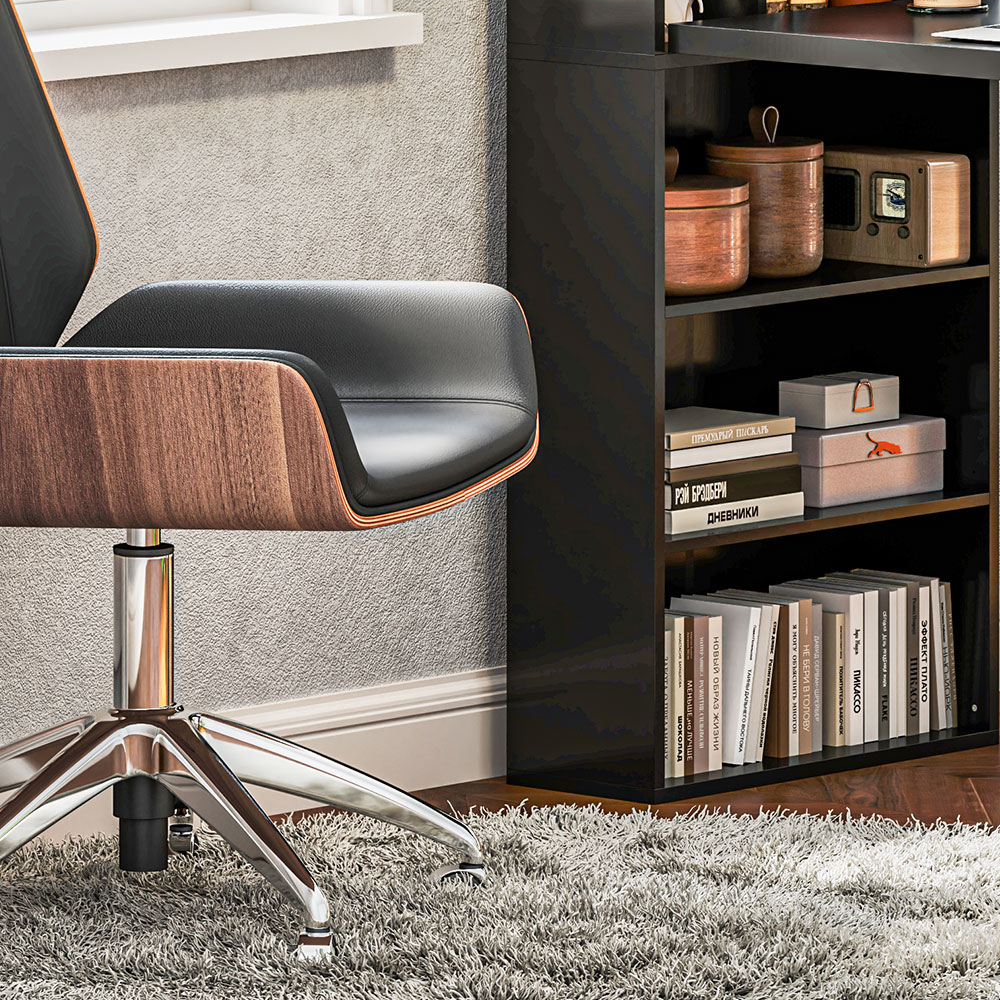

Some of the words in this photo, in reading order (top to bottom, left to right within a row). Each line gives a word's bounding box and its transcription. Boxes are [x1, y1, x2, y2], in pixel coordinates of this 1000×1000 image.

[692, 429, 734, 444] ПРЕМУДРЫЙ
[675, 483, 689, 505] РЭЙ
[692, 481, 727, 502] БРЭДБЕРИ
[707, 506, 759, 525] ДНЕВНИКИ
[803, 645, 809, 656] НЕ
[853, 670, 861, 713] ПИКАССО
[910, 657, 918, 717] ПИКАССО
